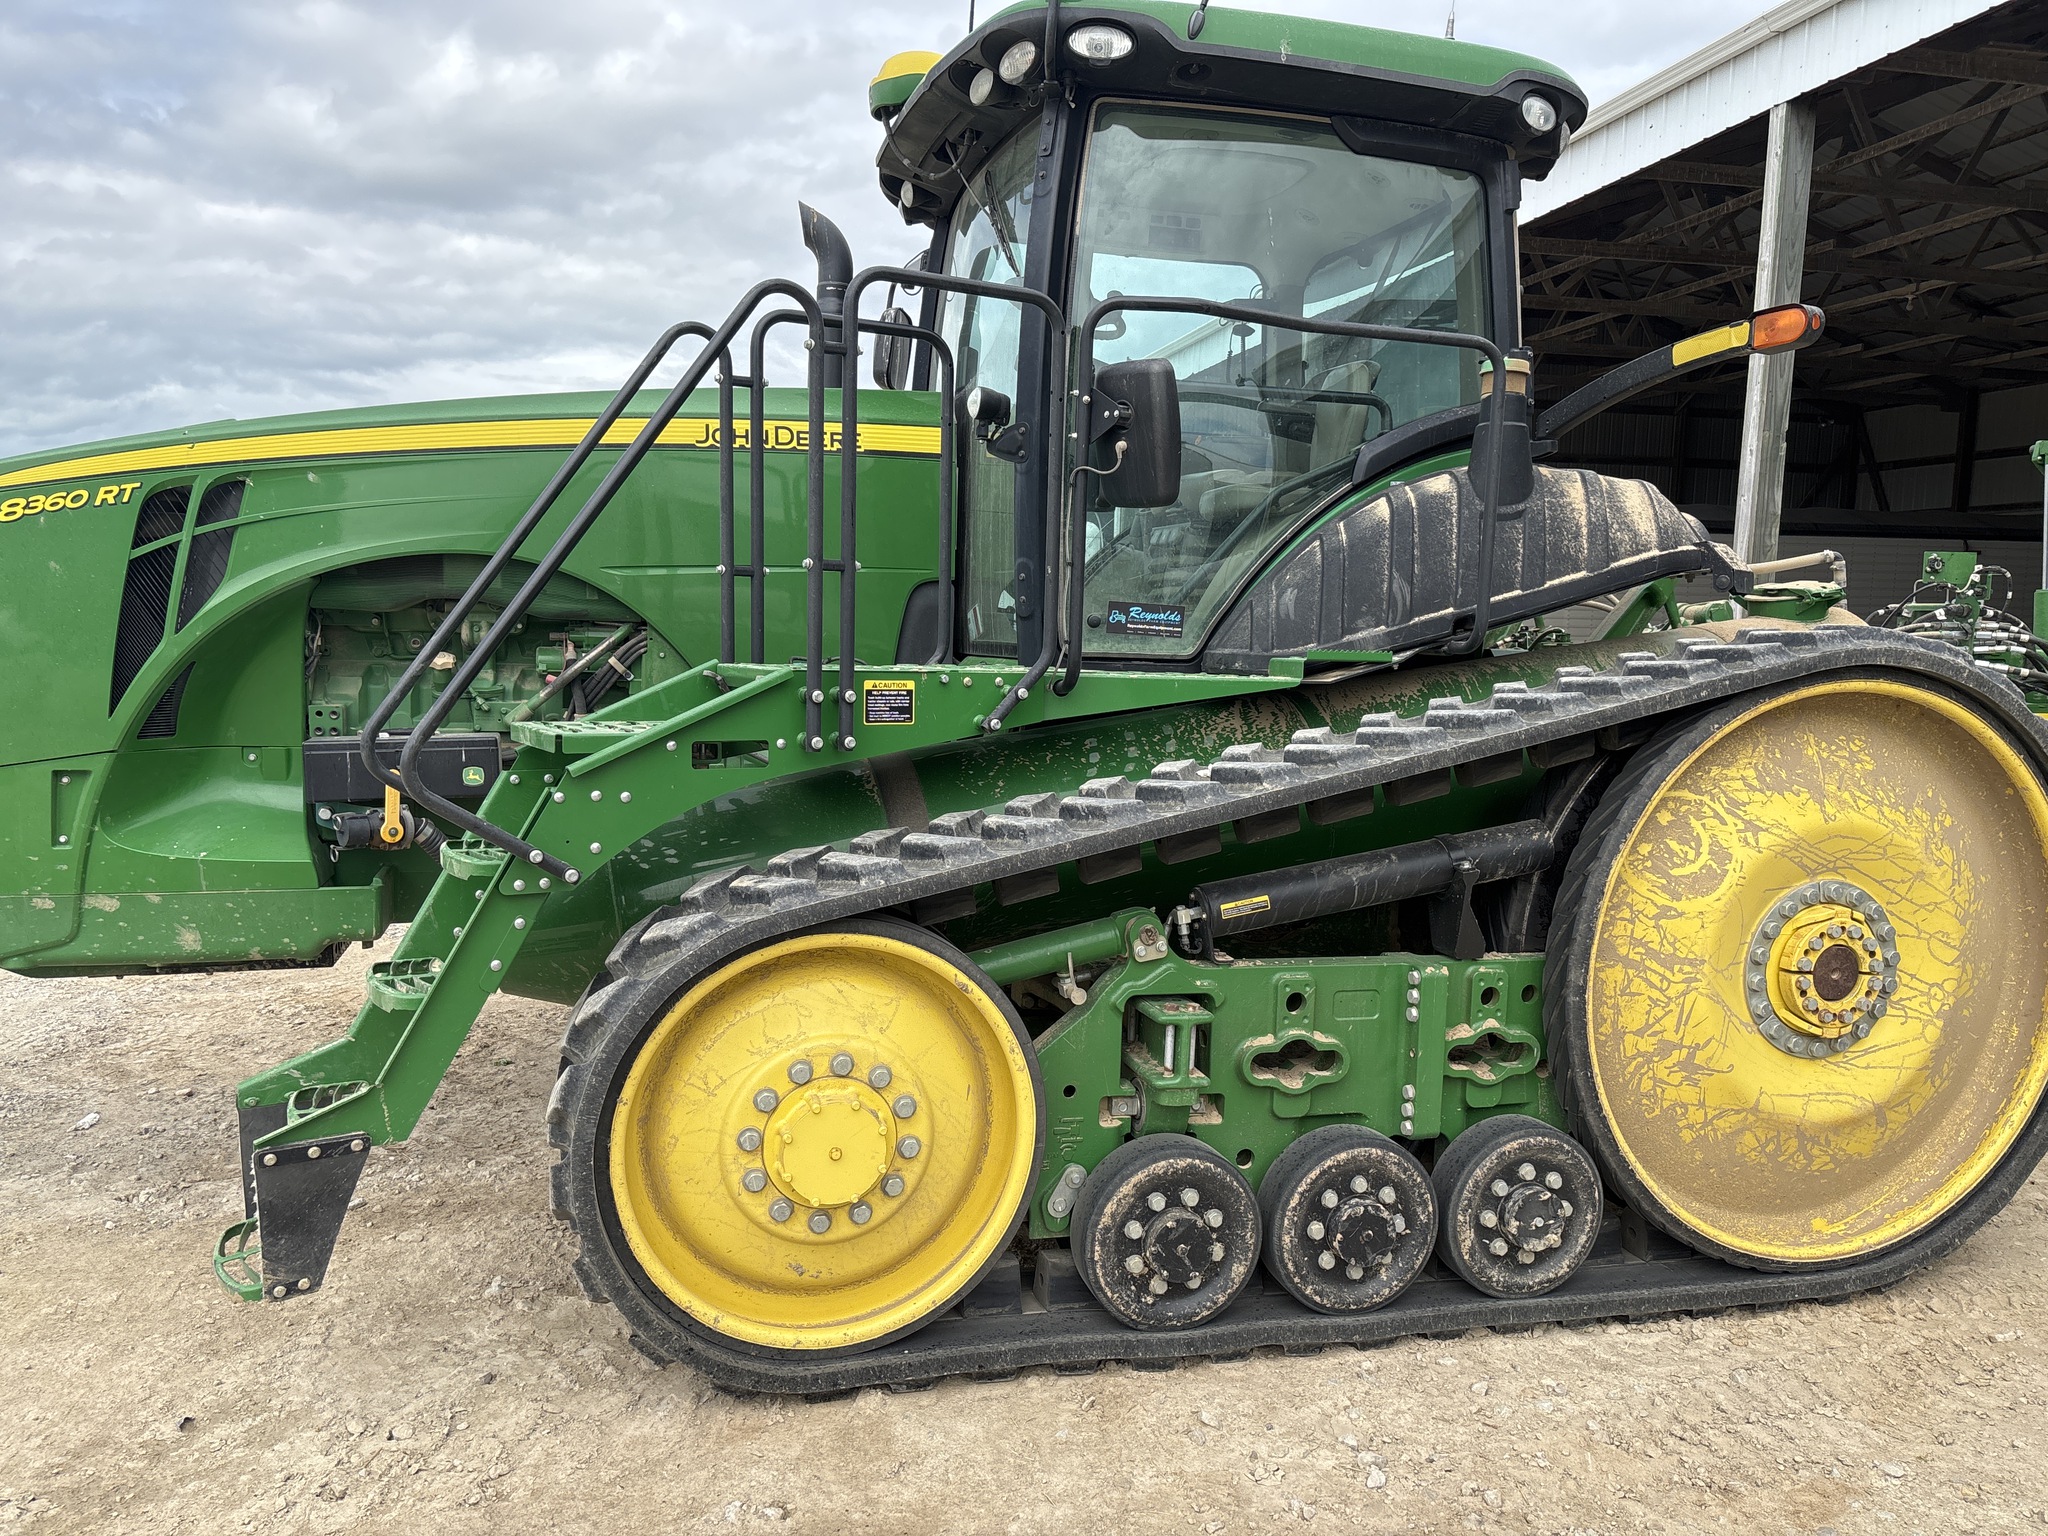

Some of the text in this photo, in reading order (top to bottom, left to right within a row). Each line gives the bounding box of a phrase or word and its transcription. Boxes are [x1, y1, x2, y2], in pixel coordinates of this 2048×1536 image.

[774, 425, 862, 449] DER
[0, 482, 142, 523] 8360 RT
[1128, 606, 1181, 621] Reynolds
